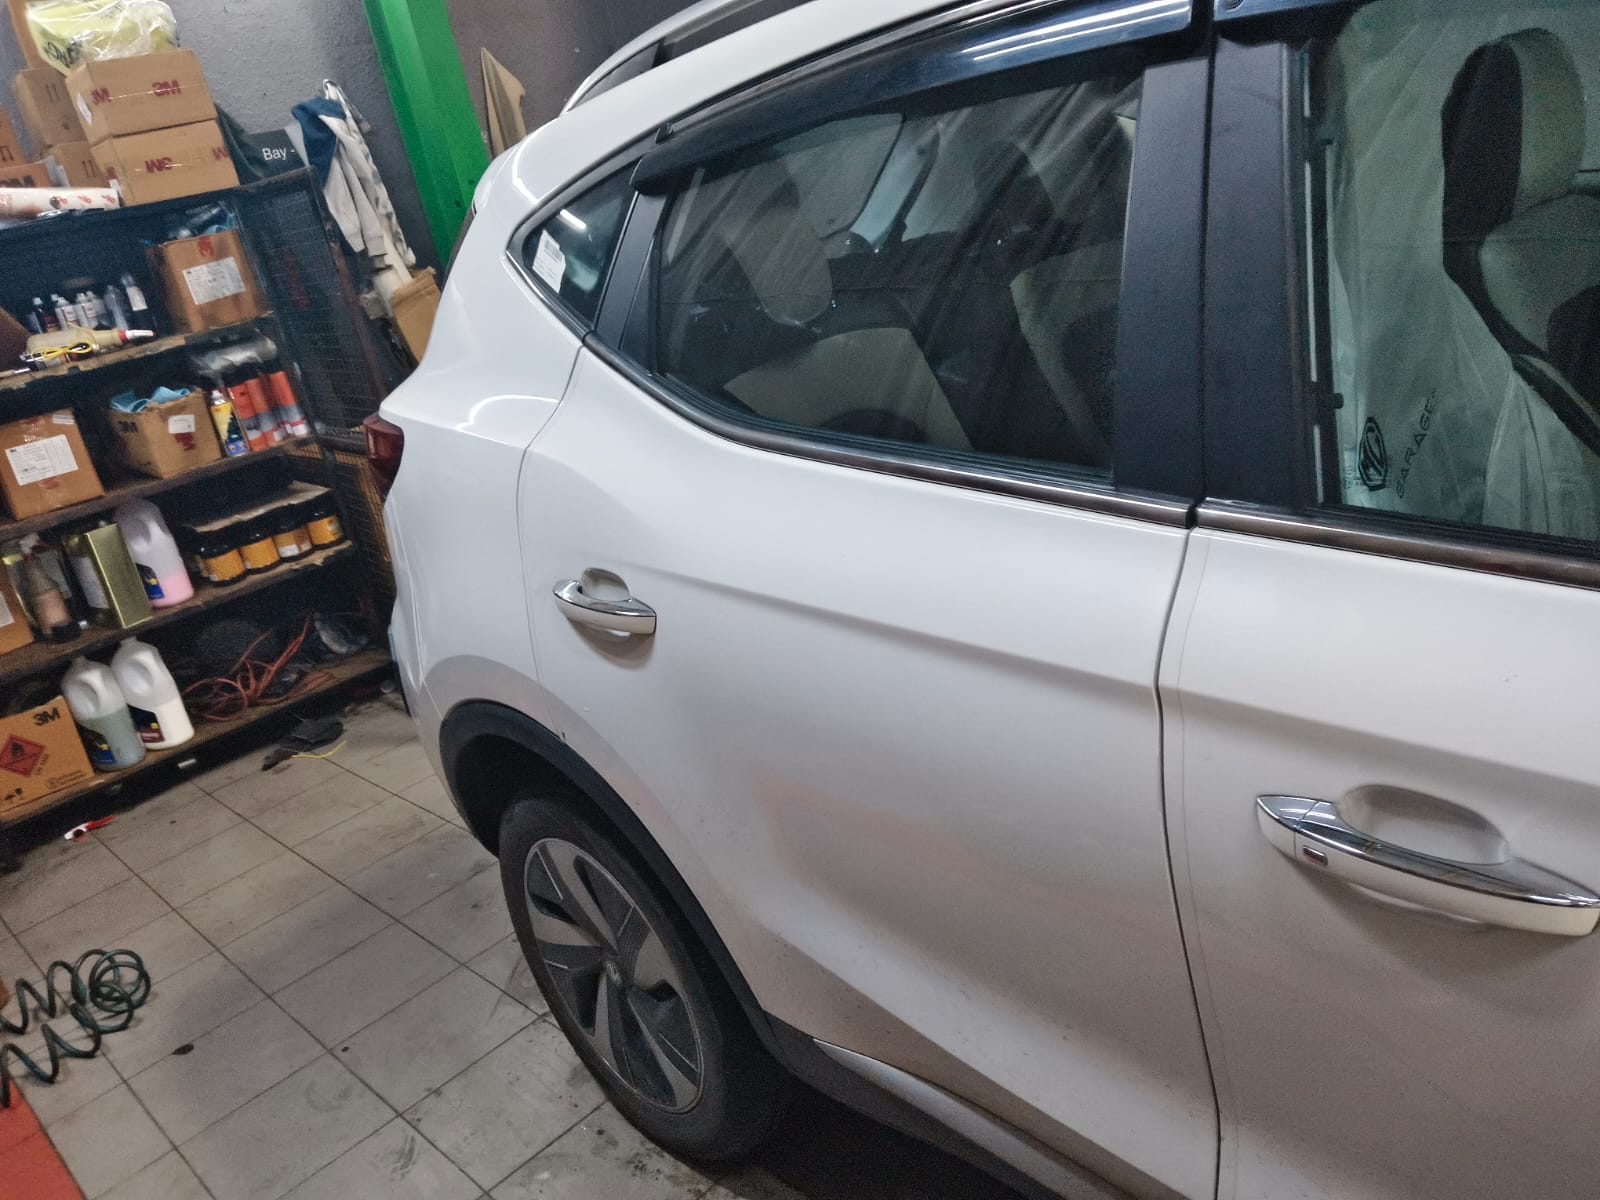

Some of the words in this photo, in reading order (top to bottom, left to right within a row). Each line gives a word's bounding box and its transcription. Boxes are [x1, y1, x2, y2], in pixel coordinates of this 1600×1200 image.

[152, 79, 181, 97] 3M
[262, 147, 287, 161] Bay
[145, 157, 173, 173] 3M
[33, 707, 61, 726] 3M
